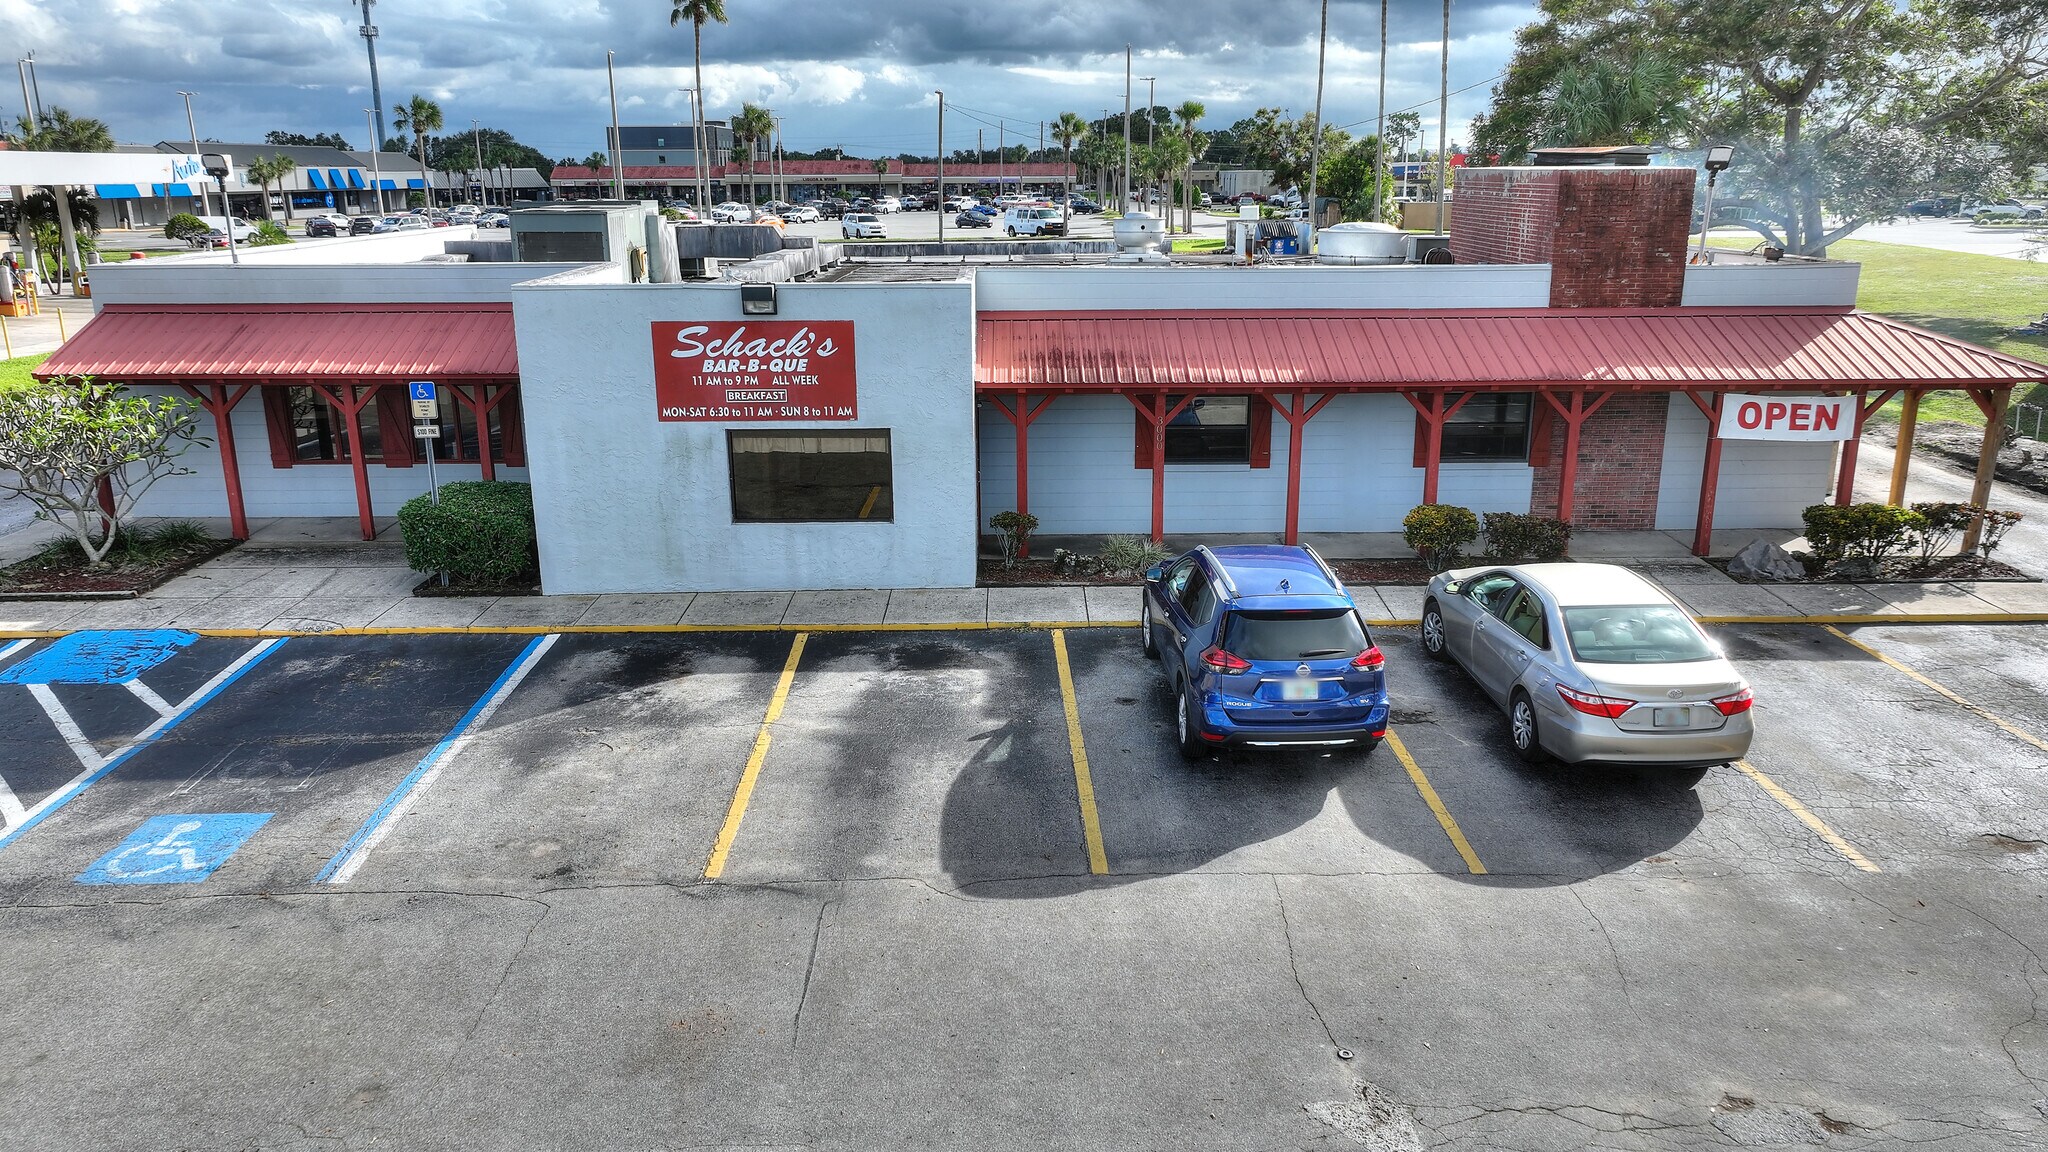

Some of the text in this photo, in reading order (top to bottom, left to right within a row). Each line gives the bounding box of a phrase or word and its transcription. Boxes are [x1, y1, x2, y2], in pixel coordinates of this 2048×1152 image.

[671, 326, 839, 358] Schack's
[702, 358, 809, 373] BAR-B-QUE
[692, 374, 819, 386] 11 AM to 9 PM ALL WEEK
[728, 391, 785, 400] BREAKFAST
[662, 406, 853, 417] MON-SAT 6:30 to 11 AM SUN 8 to 11 AM
[1737, 401, 1841, 431] OPEN
